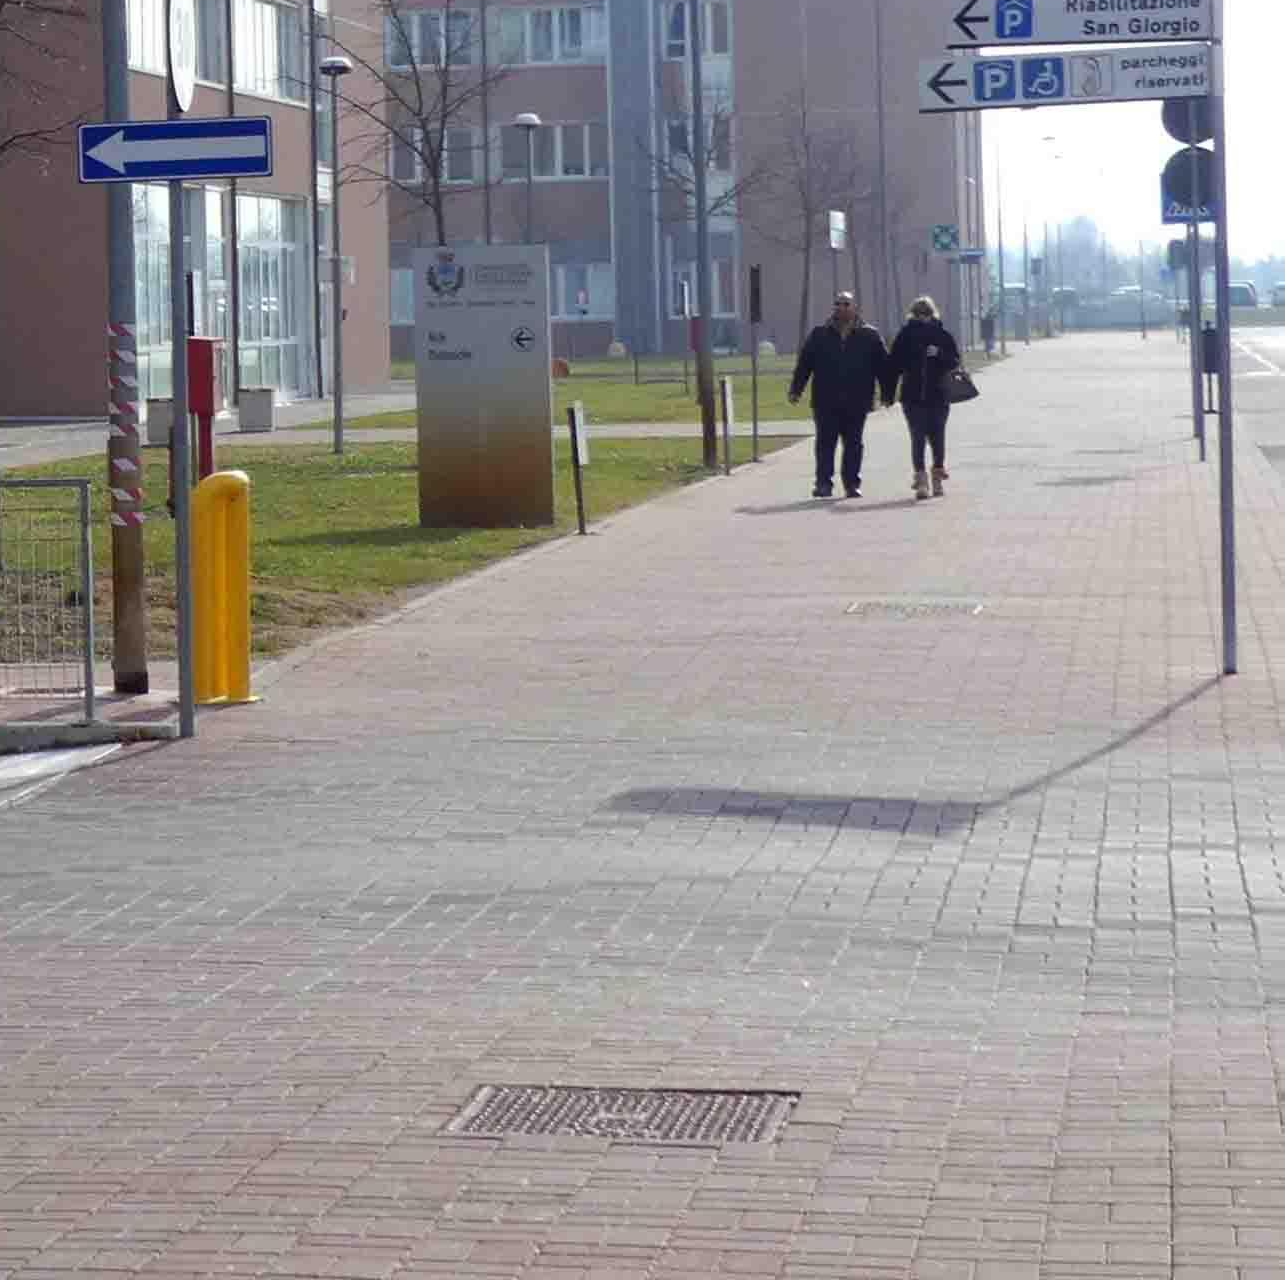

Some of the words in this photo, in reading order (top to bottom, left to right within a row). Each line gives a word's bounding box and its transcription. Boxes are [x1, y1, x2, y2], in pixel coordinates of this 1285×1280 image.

[1003, 9, 1023, 36] P
[1082, 19, 1119, 36] San
[1128, 17, 1200, 36] Giorgio
[982, 68, 1008, 99] P
